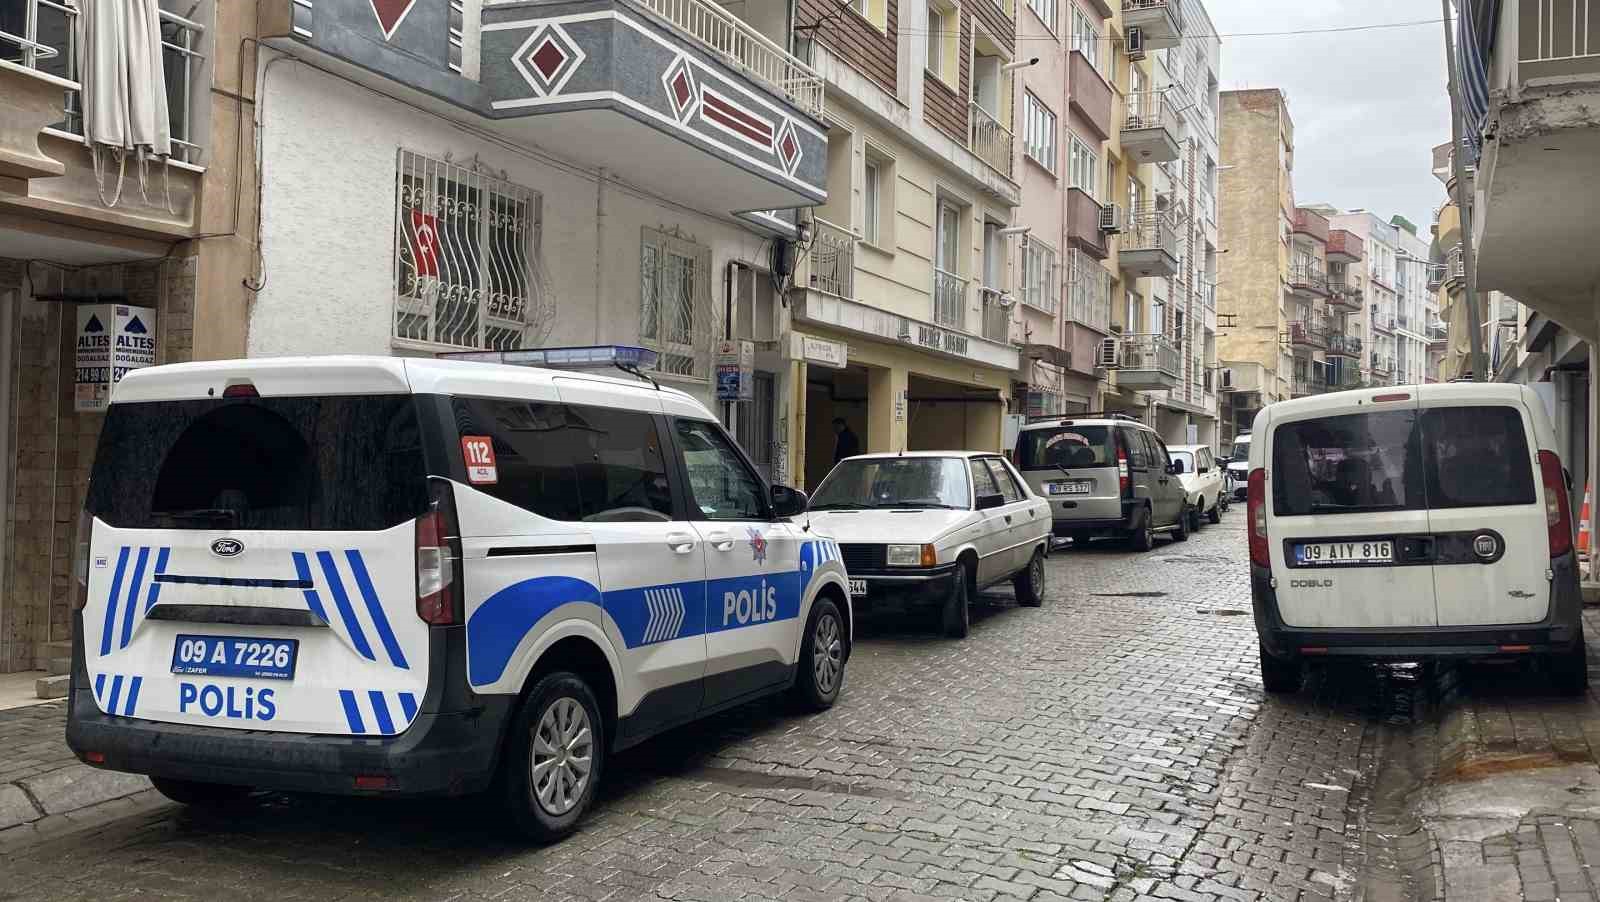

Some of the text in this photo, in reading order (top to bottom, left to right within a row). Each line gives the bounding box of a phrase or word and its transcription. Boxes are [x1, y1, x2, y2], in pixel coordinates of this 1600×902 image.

[78, 336, 110, 347] ALTES
[116, 336, 154, 349] ALTES
[467, 441, 491, 464] 112
[215, 540, 237, 553] Ford
[1304, 543, 1390, 560] 09 AIY 816
[1290, 579, 1333, 588] DOBLO
[180, 639, 290, 668] 09 A 7226
